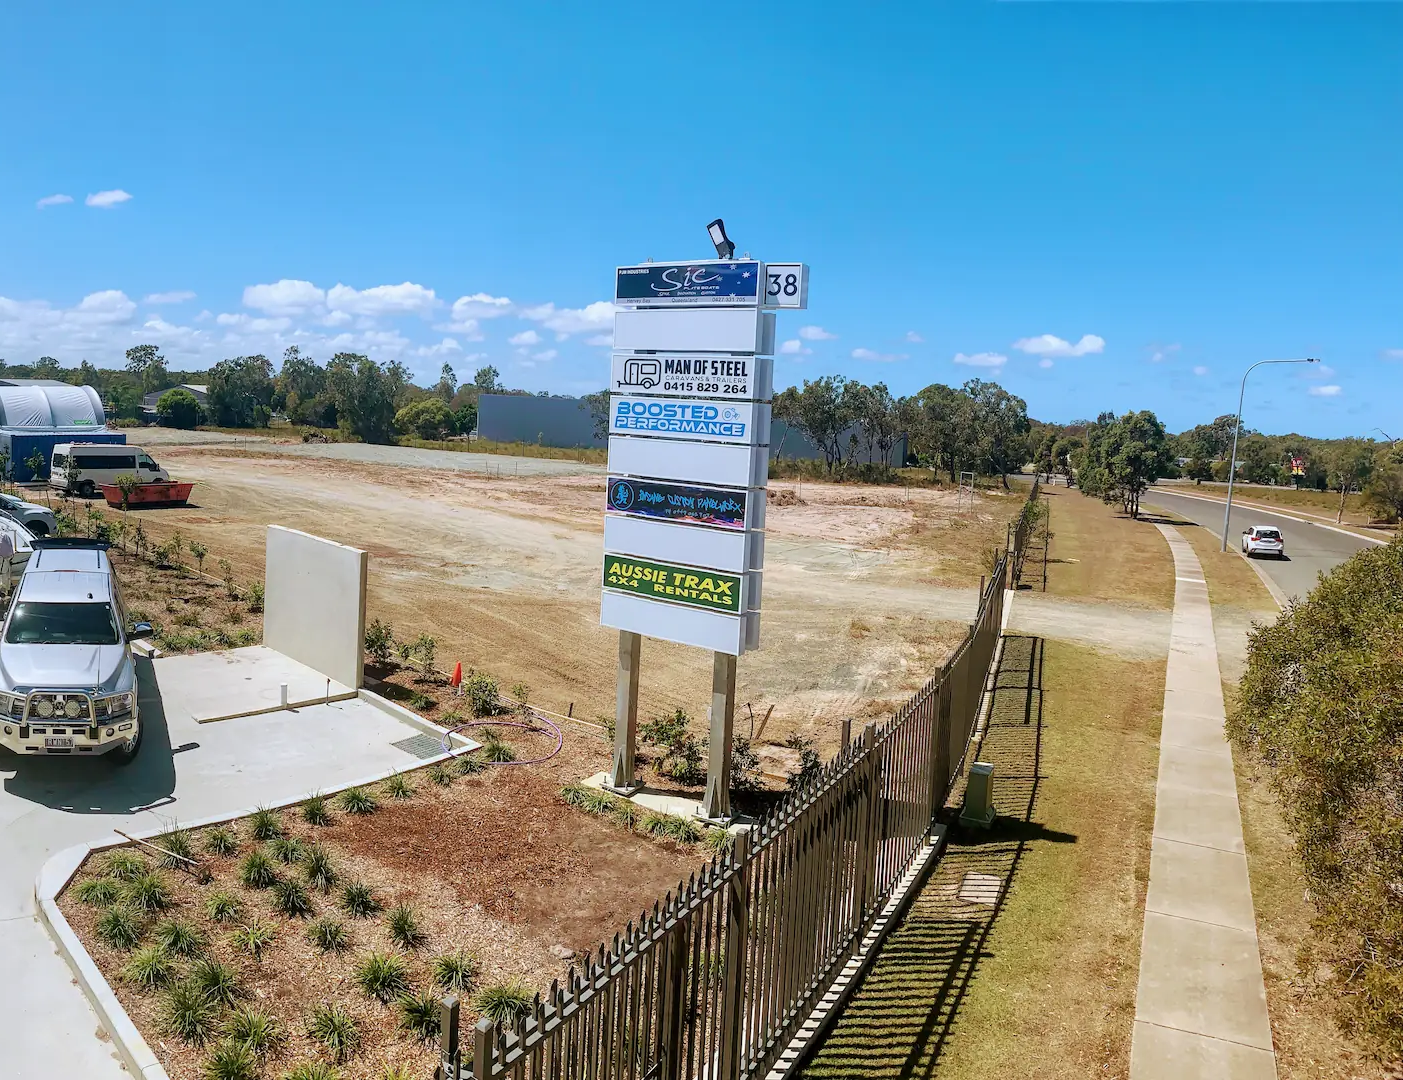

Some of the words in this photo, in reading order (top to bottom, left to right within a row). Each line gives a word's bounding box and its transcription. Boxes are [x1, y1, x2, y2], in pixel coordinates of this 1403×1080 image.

[651, 268, 720, 292] Sic
[768, 274, 798, 296] 38
[664, 360, 691, 374] MAN
[694, 360, 708, 374] OF
[711, 360, 748, 376] STEEL
[664, 382, 693, 391] 0415
[697, 382, 718, 392] 829
[723, 384, 748, 394] 264
[618, 402, 718, 420] BOOSTED
[616, 417, 743, 435] PERFORMANCE
[609, 562, 667, 583] AUSSIE
[673, 573, 734, 594] TRAX
[608, 576, 638, 588] 4X4
[654, 584, 732, 604] RENTALS
